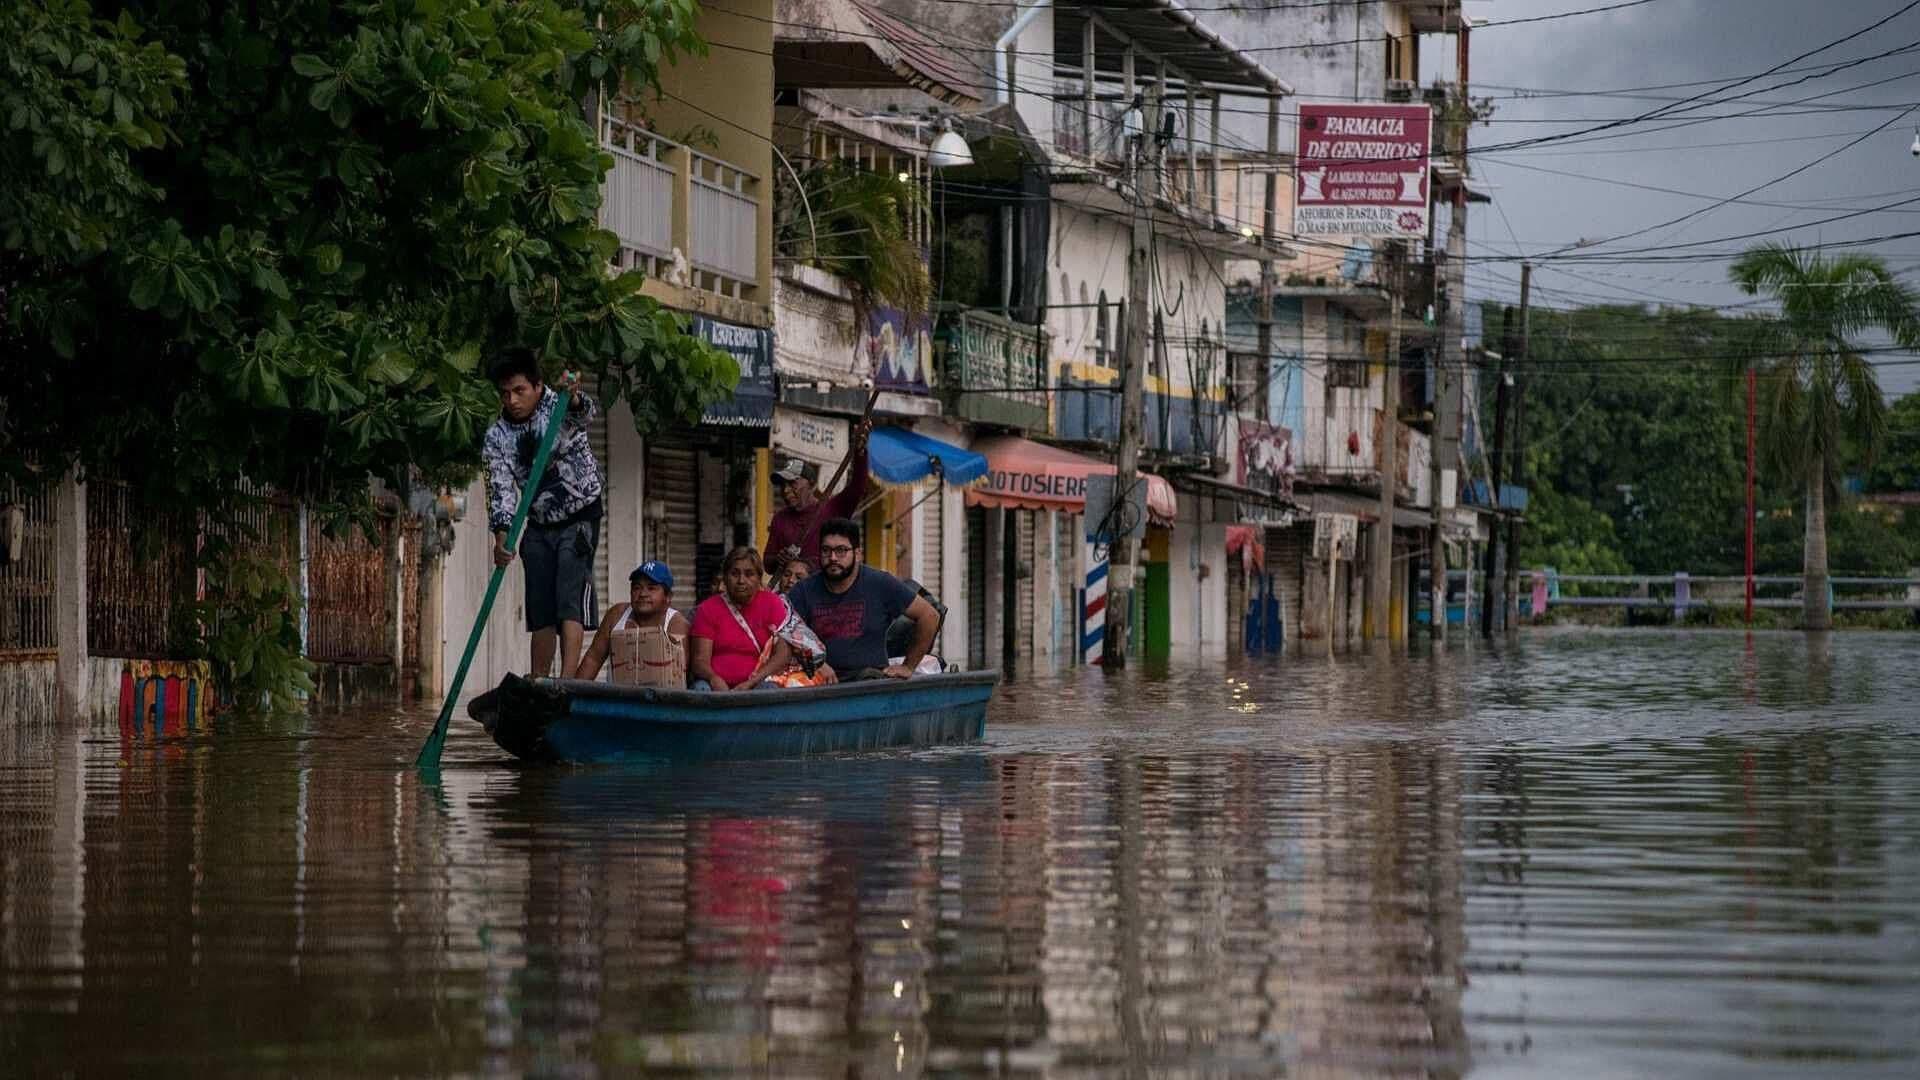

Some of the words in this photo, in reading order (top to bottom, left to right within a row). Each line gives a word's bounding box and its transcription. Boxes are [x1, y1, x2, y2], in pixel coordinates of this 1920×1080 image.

[1323, 116, 1405, 136] FARMACIA
[1306, 141, 1330, 158] DE
[1330, 141, 1422, 160] GENERICOS
[1298, 208, 1344, 220] AHORROS
[1346, 208, 1378, 220] HASTA
[1379, 208, 1393, 220] DE
[1327, 221, 1341, 233] EN
[1342, 221, 1393, 233] MEDICINAS
